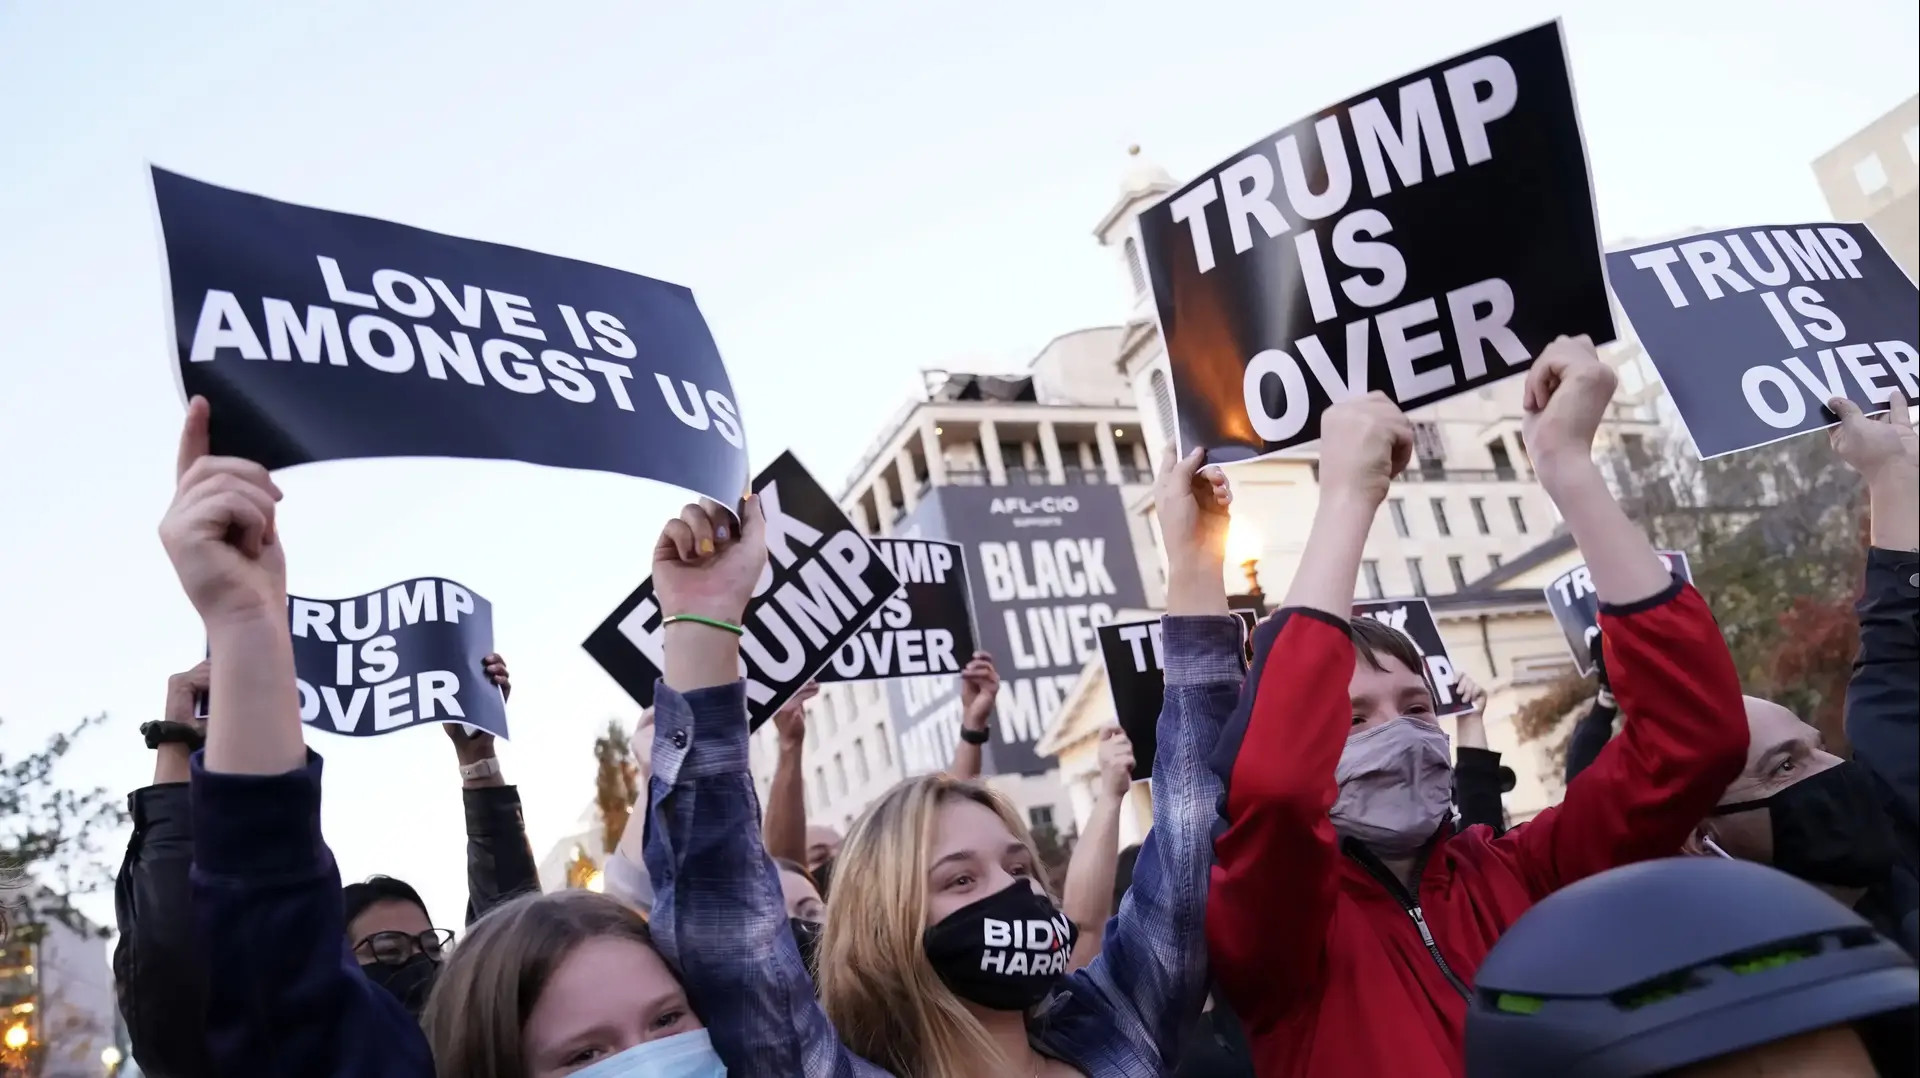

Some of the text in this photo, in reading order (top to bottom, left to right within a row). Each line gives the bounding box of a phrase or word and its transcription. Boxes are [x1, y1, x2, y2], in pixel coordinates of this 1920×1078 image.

[1169, 55, 1518, 274] TRUMP
[316, 255, 638, 359] LOVE IS
[1294, 209, 1407, 324] IS
[1630, 227, 1863, 308] TRUMP
[1243, 278, 1532, 443] OVER
[1760, 286, 1846, 349] IS
[190, 289, 743, 449] AMONGST US
[1741, 340, 1919, 429] OVER
[990, 496, 1079, 515] AFL-CIO
[287, 580, 475, 642] RUMP
[618, 479, 824, 684] FK
[979, 538, 1116, 602] BLACK
[336, 635, 399, 686] IS
[739, 529, 875, 720] UMP
[831, 628, 960, 679] OVER
